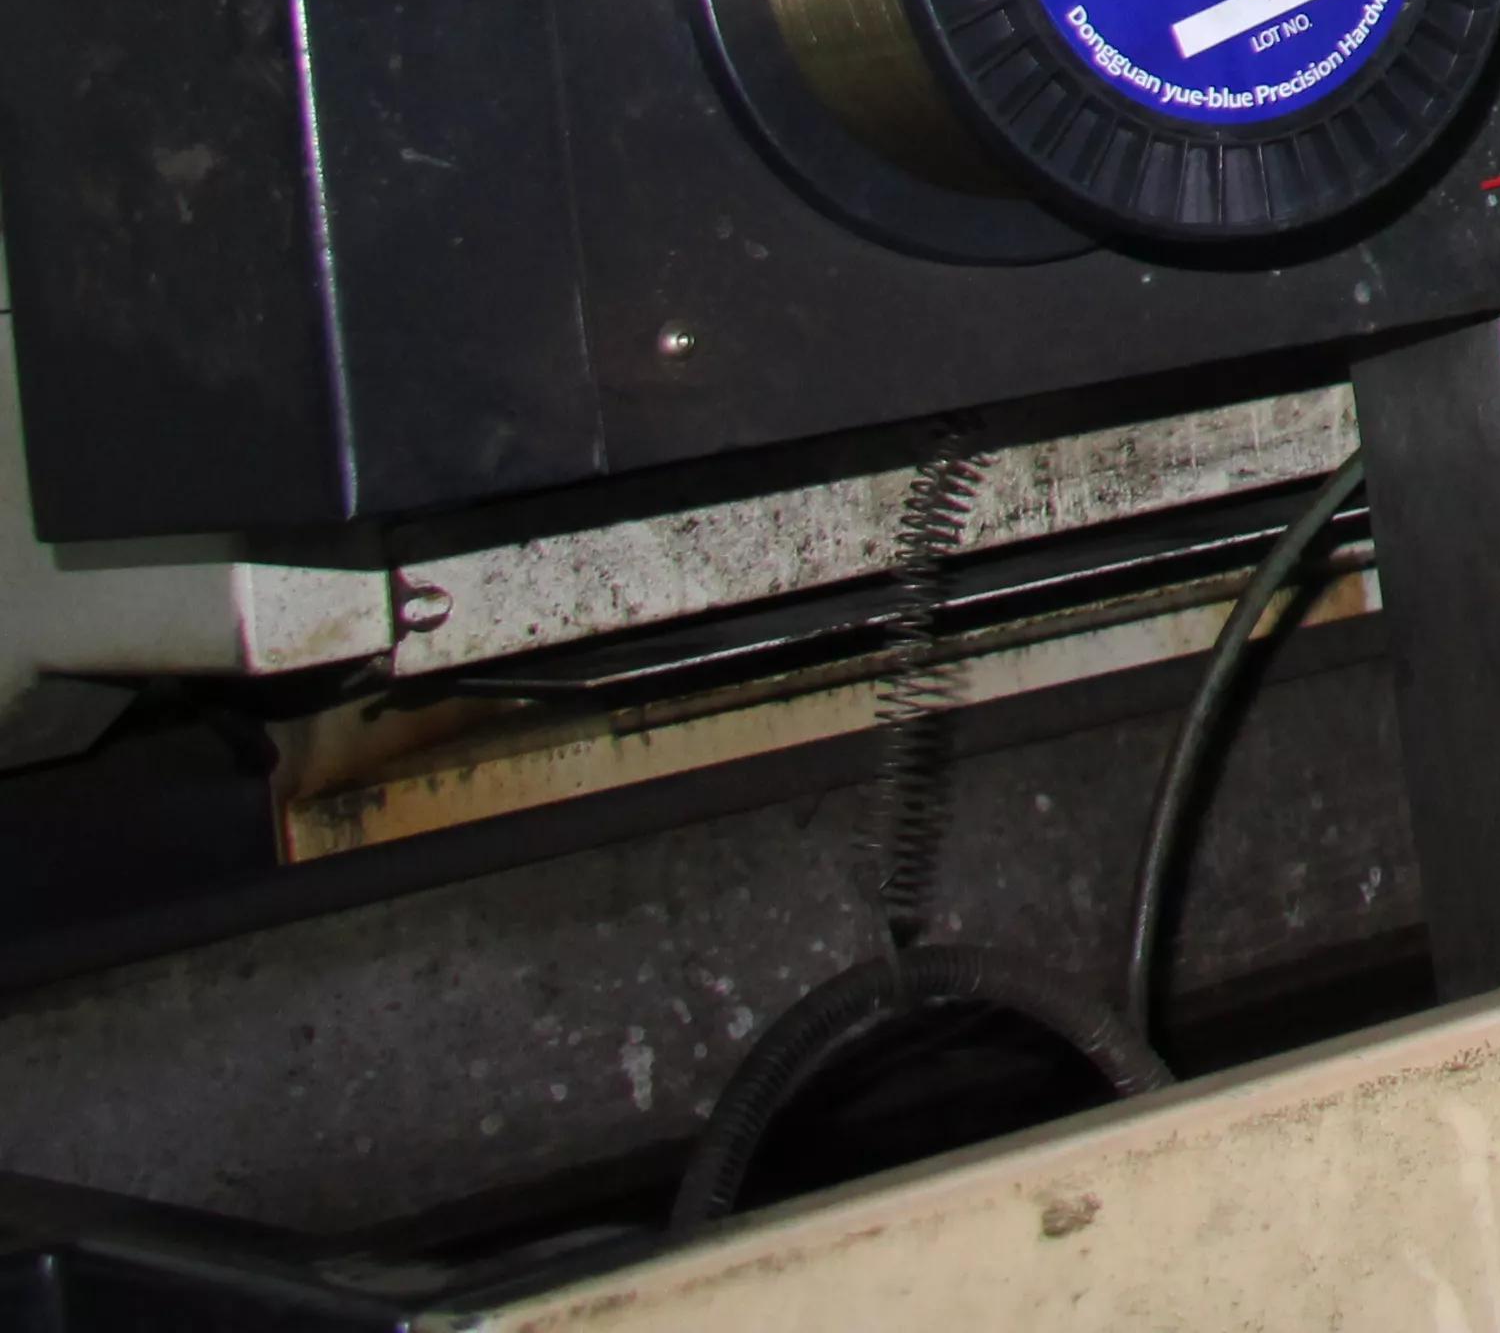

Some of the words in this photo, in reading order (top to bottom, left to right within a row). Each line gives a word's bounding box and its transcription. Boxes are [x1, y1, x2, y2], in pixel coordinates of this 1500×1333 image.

[1066, 5, 1162, 94] Dongguan
[1161, 82, 1254, 109] yue-blue
[1255, 49, 1344, 106] Precision
[1251, 25, 1283, 53] LOT
[1282, 14, 1313, 39] NO.
